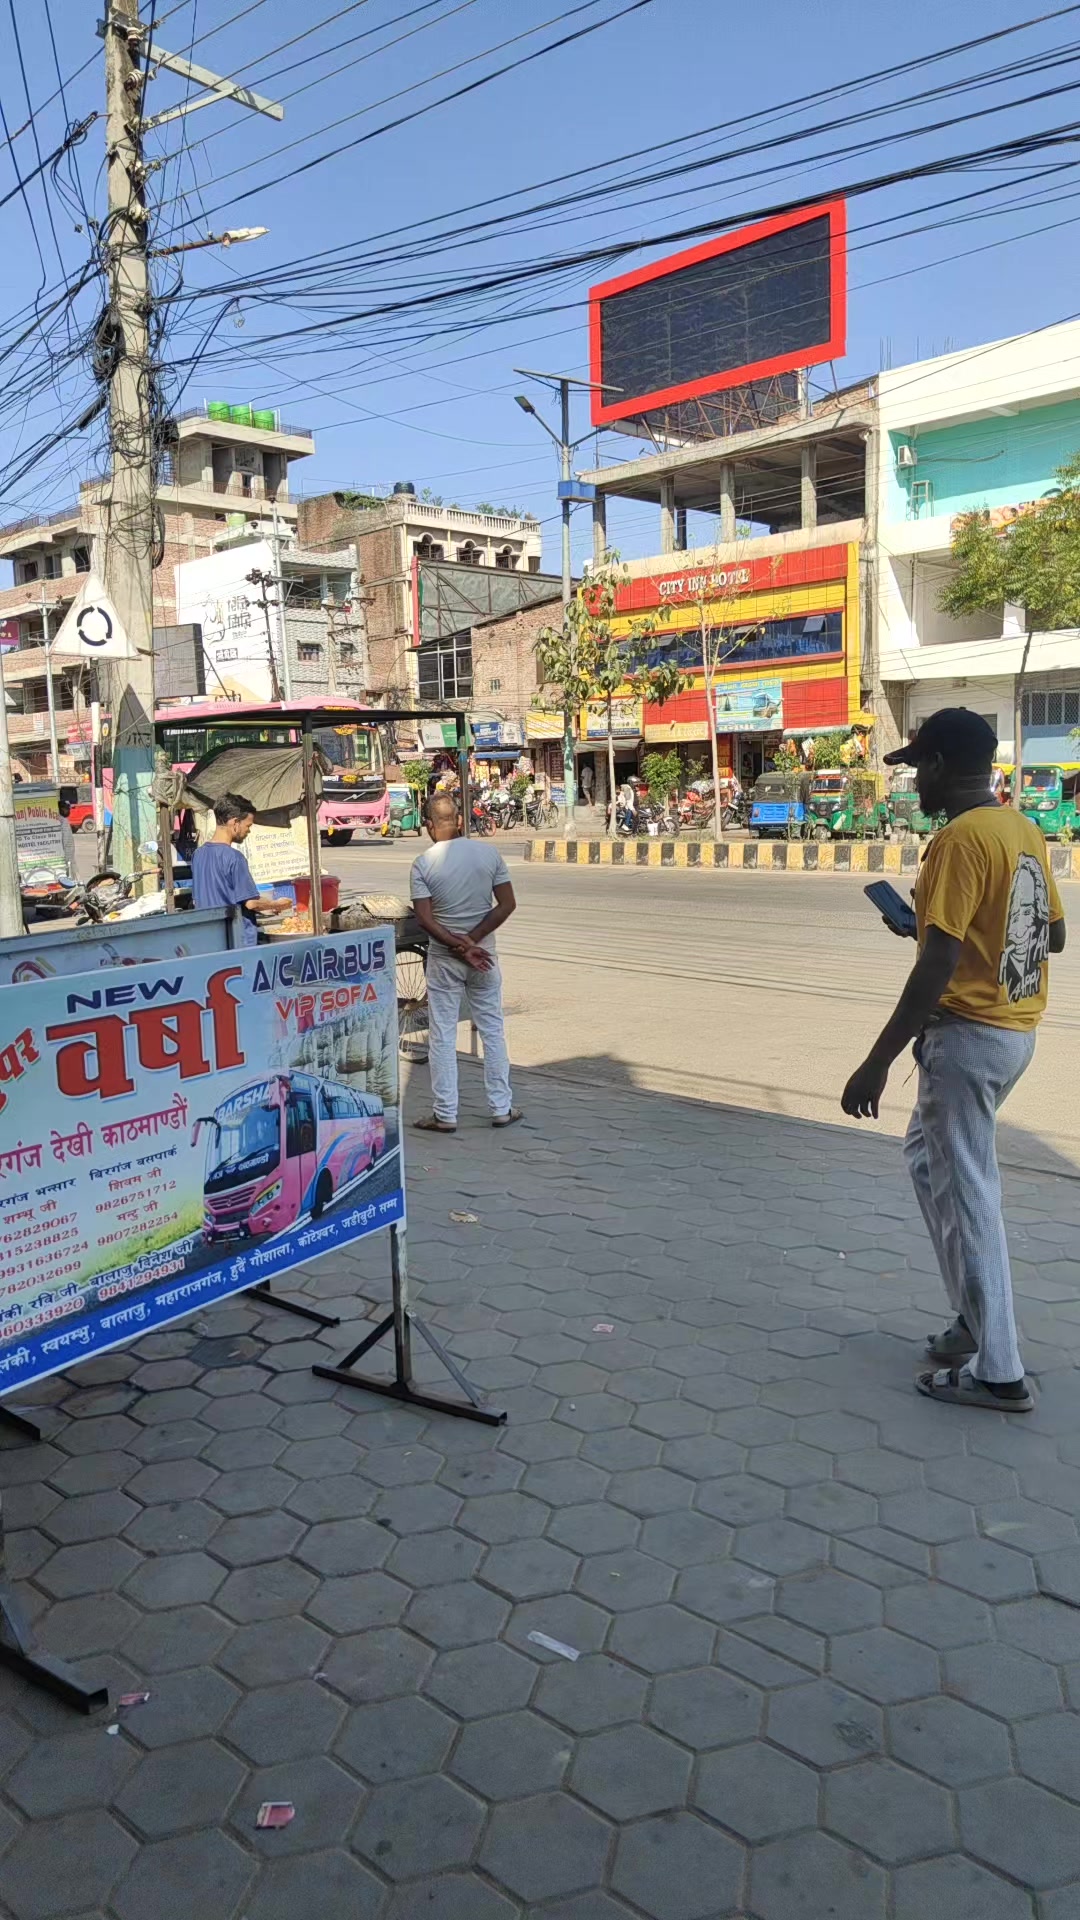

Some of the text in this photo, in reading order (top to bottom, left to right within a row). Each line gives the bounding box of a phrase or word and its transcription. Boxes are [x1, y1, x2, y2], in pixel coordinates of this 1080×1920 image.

[660, 579, 684, 596] CITY
[252, 940, 386, 994] A/C AIR BUS
[67, 976, 184, 1014] NEW
[275, 983, 379, 1022] VIP SOFA
[45, 966, 246, 1099] वर्षा
[50, 1121, 93, 1163] देखी
[147, 1167, 162, 1181] जी
[40, 1199, 57, 1212] जी
[95, 1180, 177, 1214] 9826751712
[143, 1200, 159, 1214] जी
[0, 1212, 78, 1243] 62829067
[97, 1212, 179, 1248] 9807282254
[100, 1302, 151, 1330] बालाजु,
[379, 1197, 398, 1214] सम्म
[176, 1239, 195, 1256] जी
[28, 1292, 55, 1309] रवि
[60, 1282, 79, 1297] जी
[100, 1258, 185, 1299] 9841294931
[0, 1298, 84, 1338] 60333920
